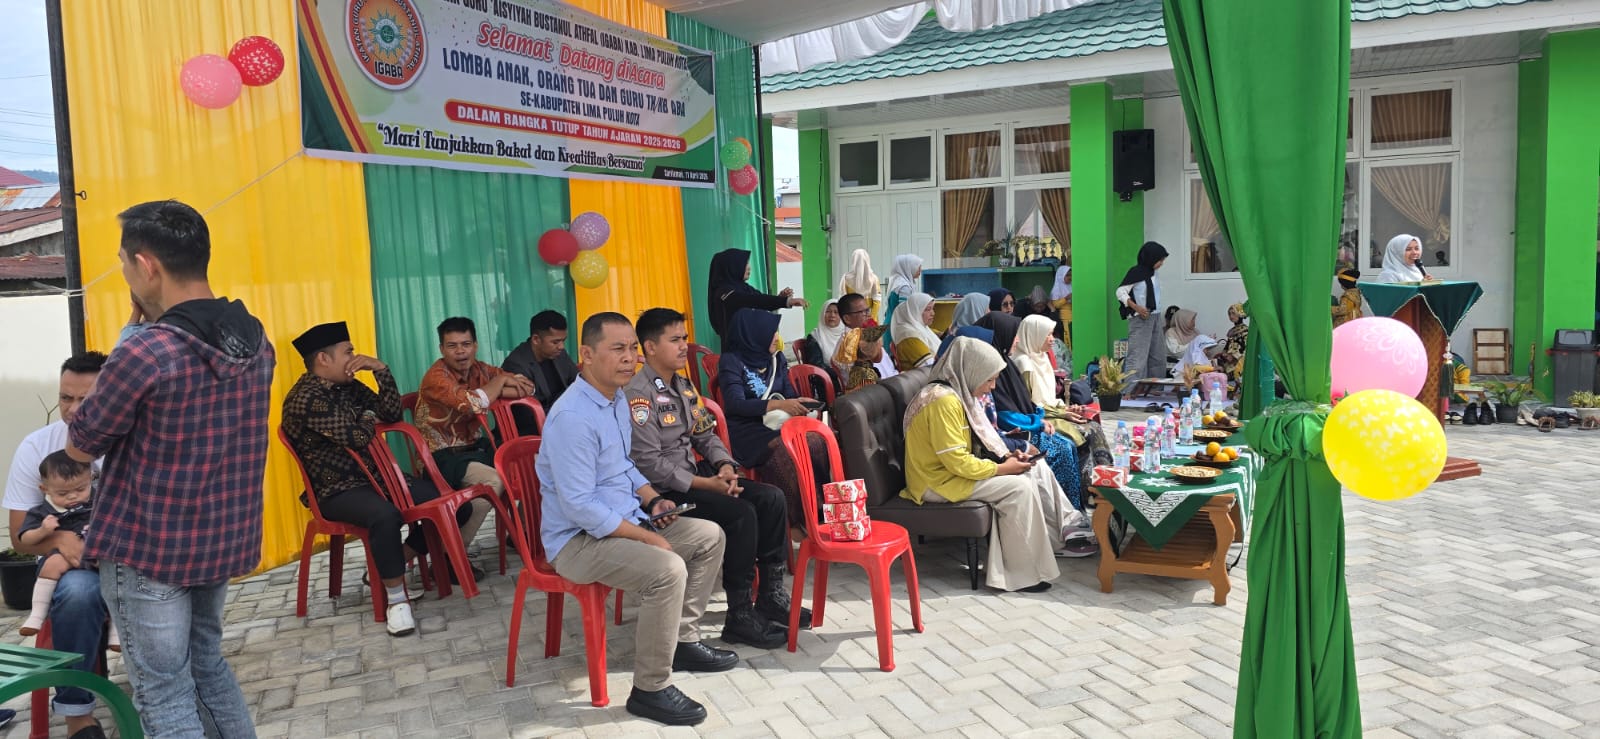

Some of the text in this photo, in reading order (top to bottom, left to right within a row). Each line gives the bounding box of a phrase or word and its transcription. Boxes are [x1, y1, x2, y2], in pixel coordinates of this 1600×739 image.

[477, 21, 666, 90] Selamat Datang diAcara
[534, 10, 572, 37] BUSTANUL
[574, 23, 599, 45] ATHFAL
[600, 31, 624, 53] (IGABA)
[625, 39, 640, 57] KAB.
[640, 44, 656, 63] LIMA
[657, 49, 674, 67] PULUH
[674, 54, 688, 70] KOTA
[374, 61, 403, 78] IGABA
[443, 47, 492, 78] LOMBA
[496, 60, 534, 88] ANAK,
[537, 69, 575, 95] ORANG
[577, 78, 596, 99] TUA
[598, 83, 618, 103] DAN
[620, 87, 644, 109] GURU
[670, 100, 686, 117] ABA
[457, 105, 501, 123] DALAM
[503, 112, 548, 130] RANGKA
[550, 119, 580, 135] TUTUP
[582, 125, 609, 140] TAHUN
[610, 131, 641, 145] AJARAN
[520, 91, 640, 126] SE-KABUPATEN LIMA PULUH KOTA
[422, 130, 494, 155] Tunjukkan
[495, 139, 531, 160] Bakat
[534, 145, 556, 162] dan
